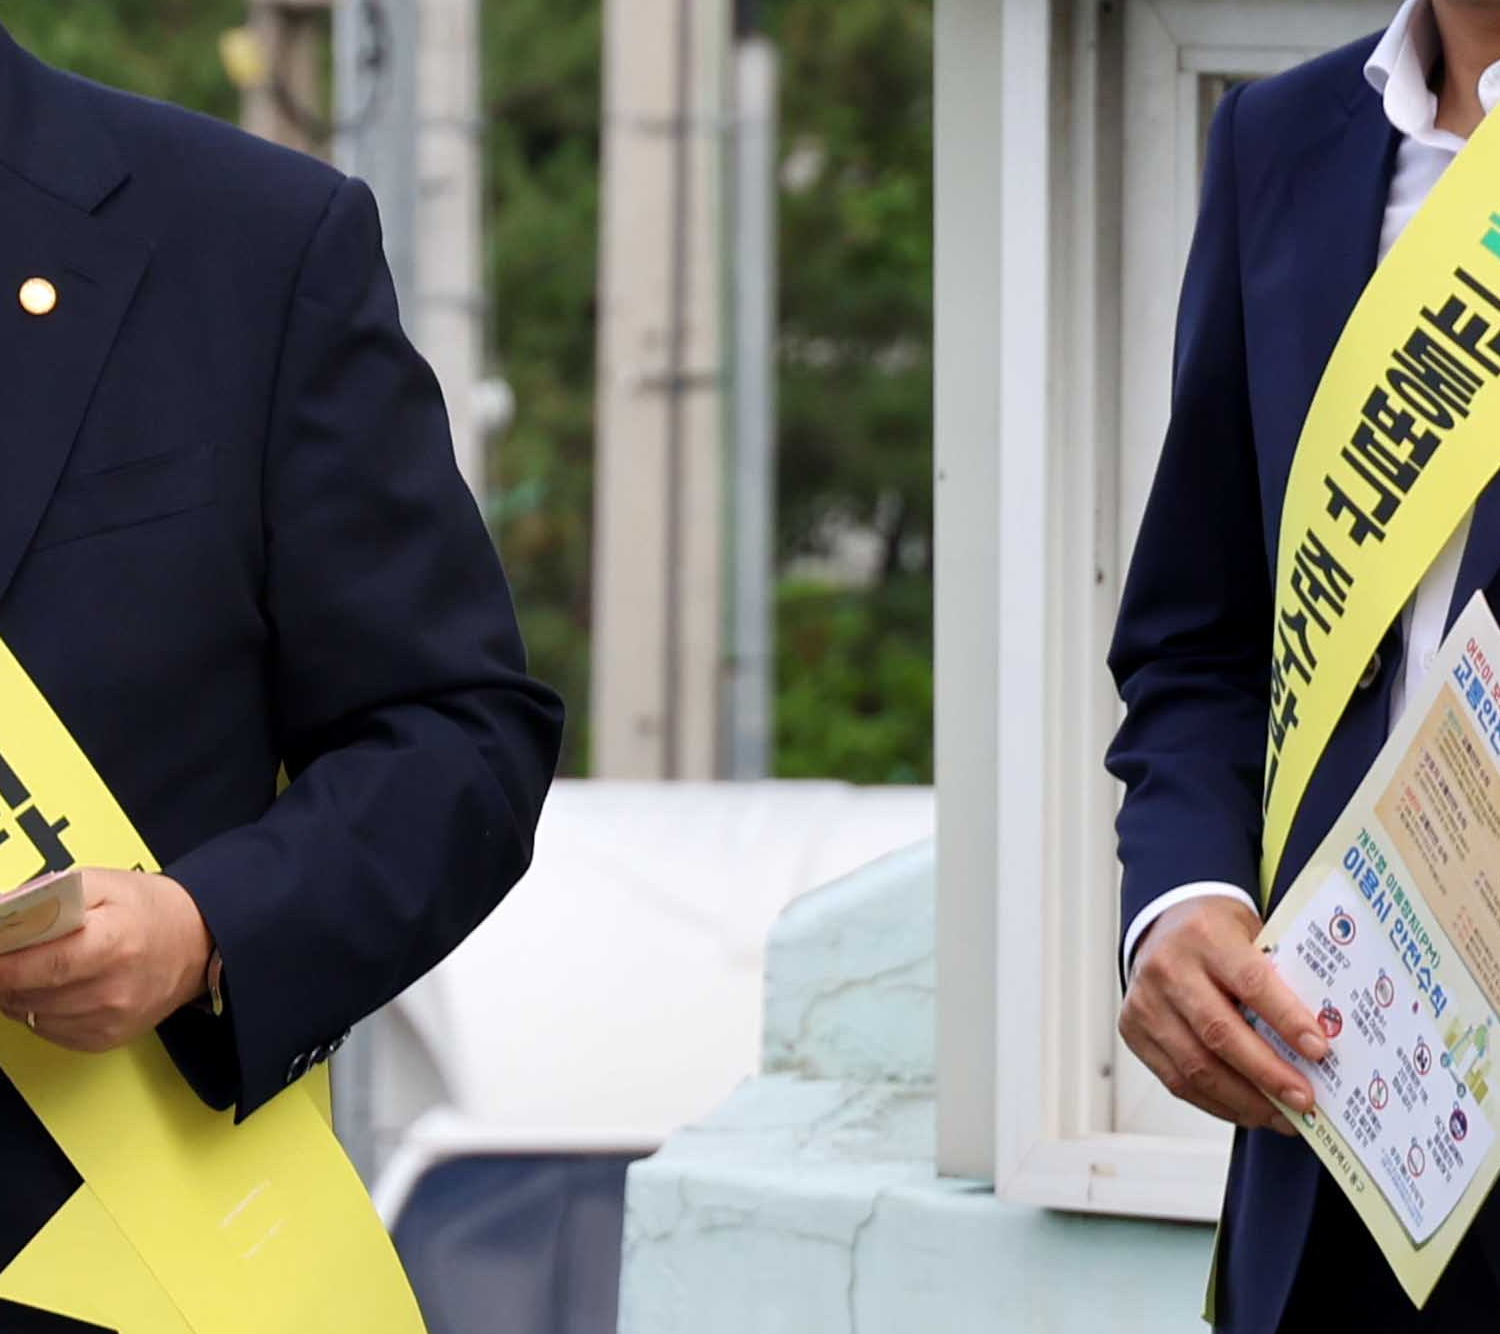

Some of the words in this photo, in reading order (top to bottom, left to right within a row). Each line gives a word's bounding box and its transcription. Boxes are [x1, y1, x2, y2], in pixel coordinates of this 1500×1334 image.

[1263, 528, 1354, 815] 준수합
[1343, 845, 1394, 924] 이용시
[1388, 917, 1448, 1020] 안전수칙
